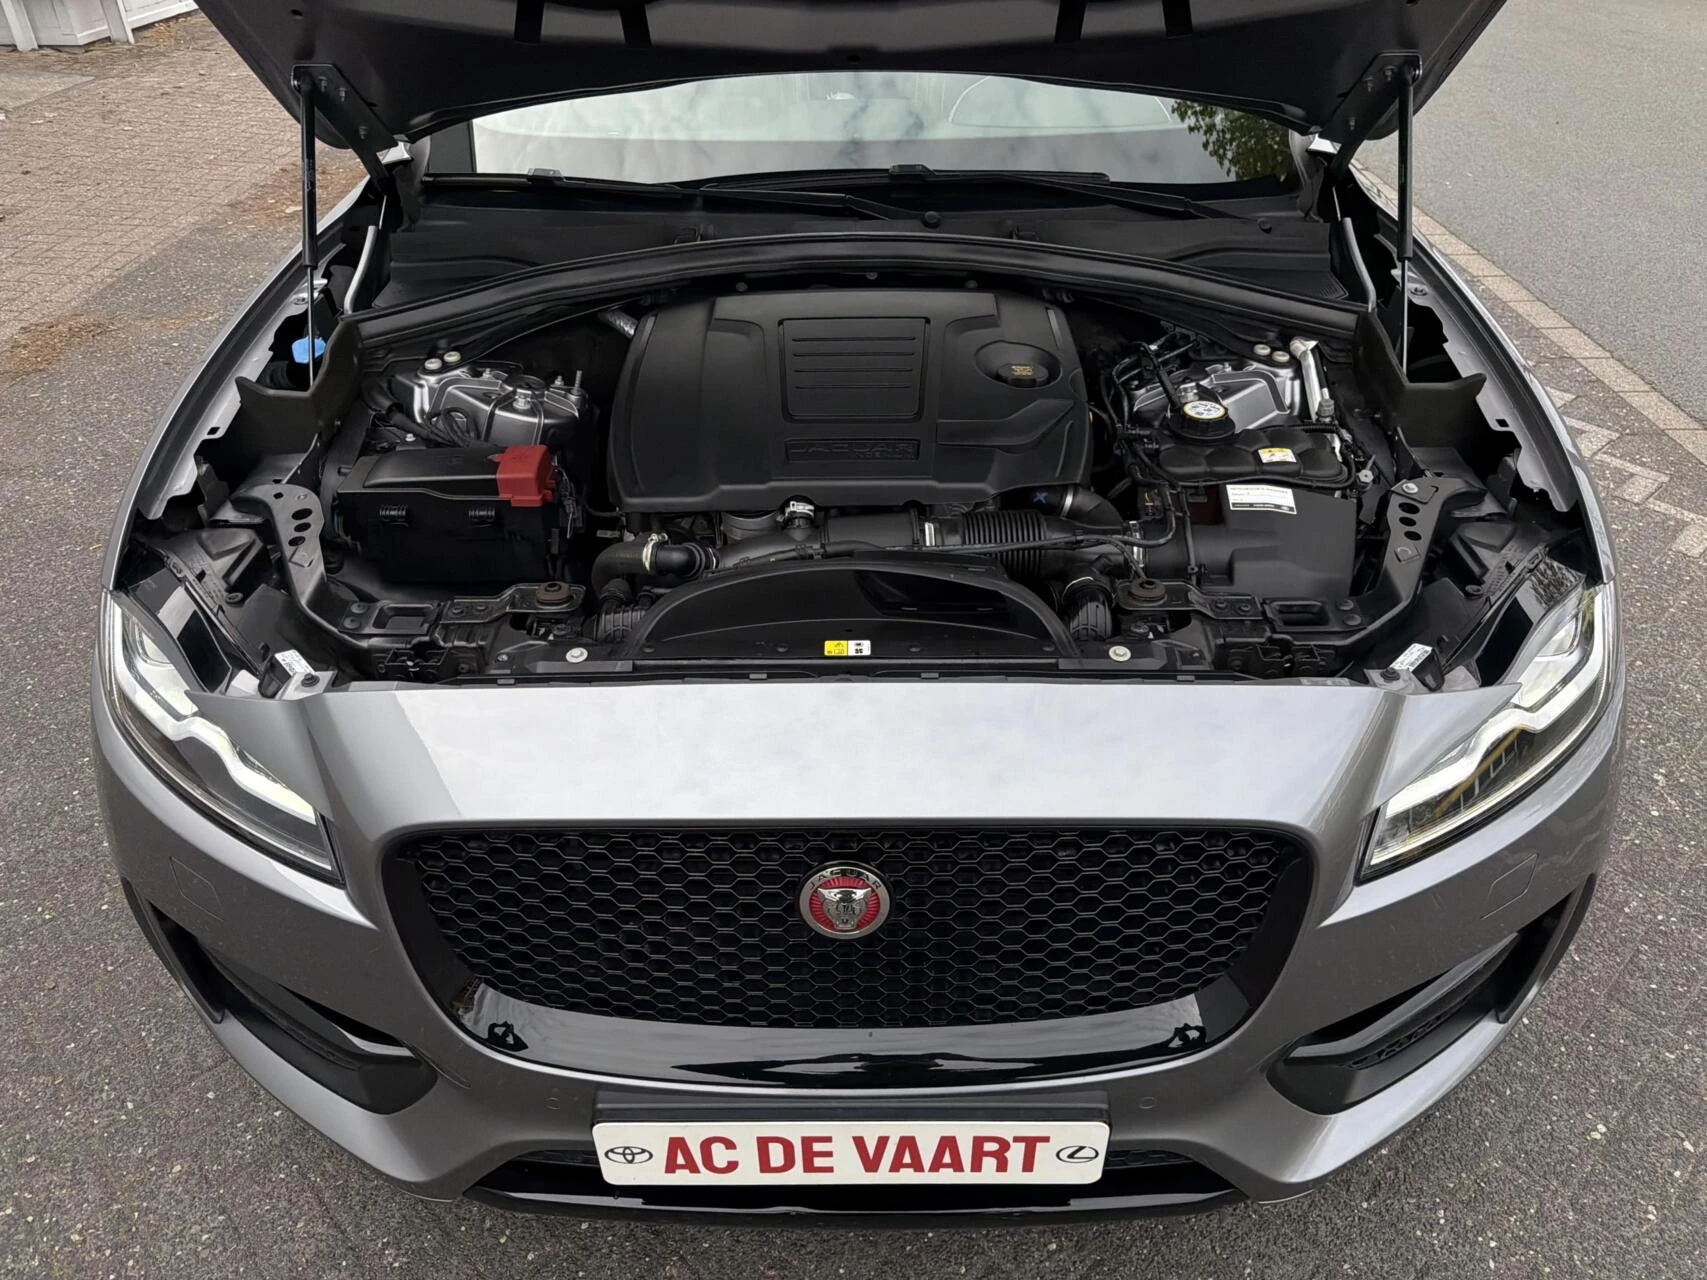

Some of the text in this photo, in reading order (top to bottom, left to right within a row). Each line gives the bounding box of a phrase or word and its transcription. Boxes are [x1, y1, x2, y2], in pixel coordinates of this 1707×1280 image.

[809, 869, 882, 891] JAGUAR
[663, 1135, 1050, 1175] AC DE VAART
